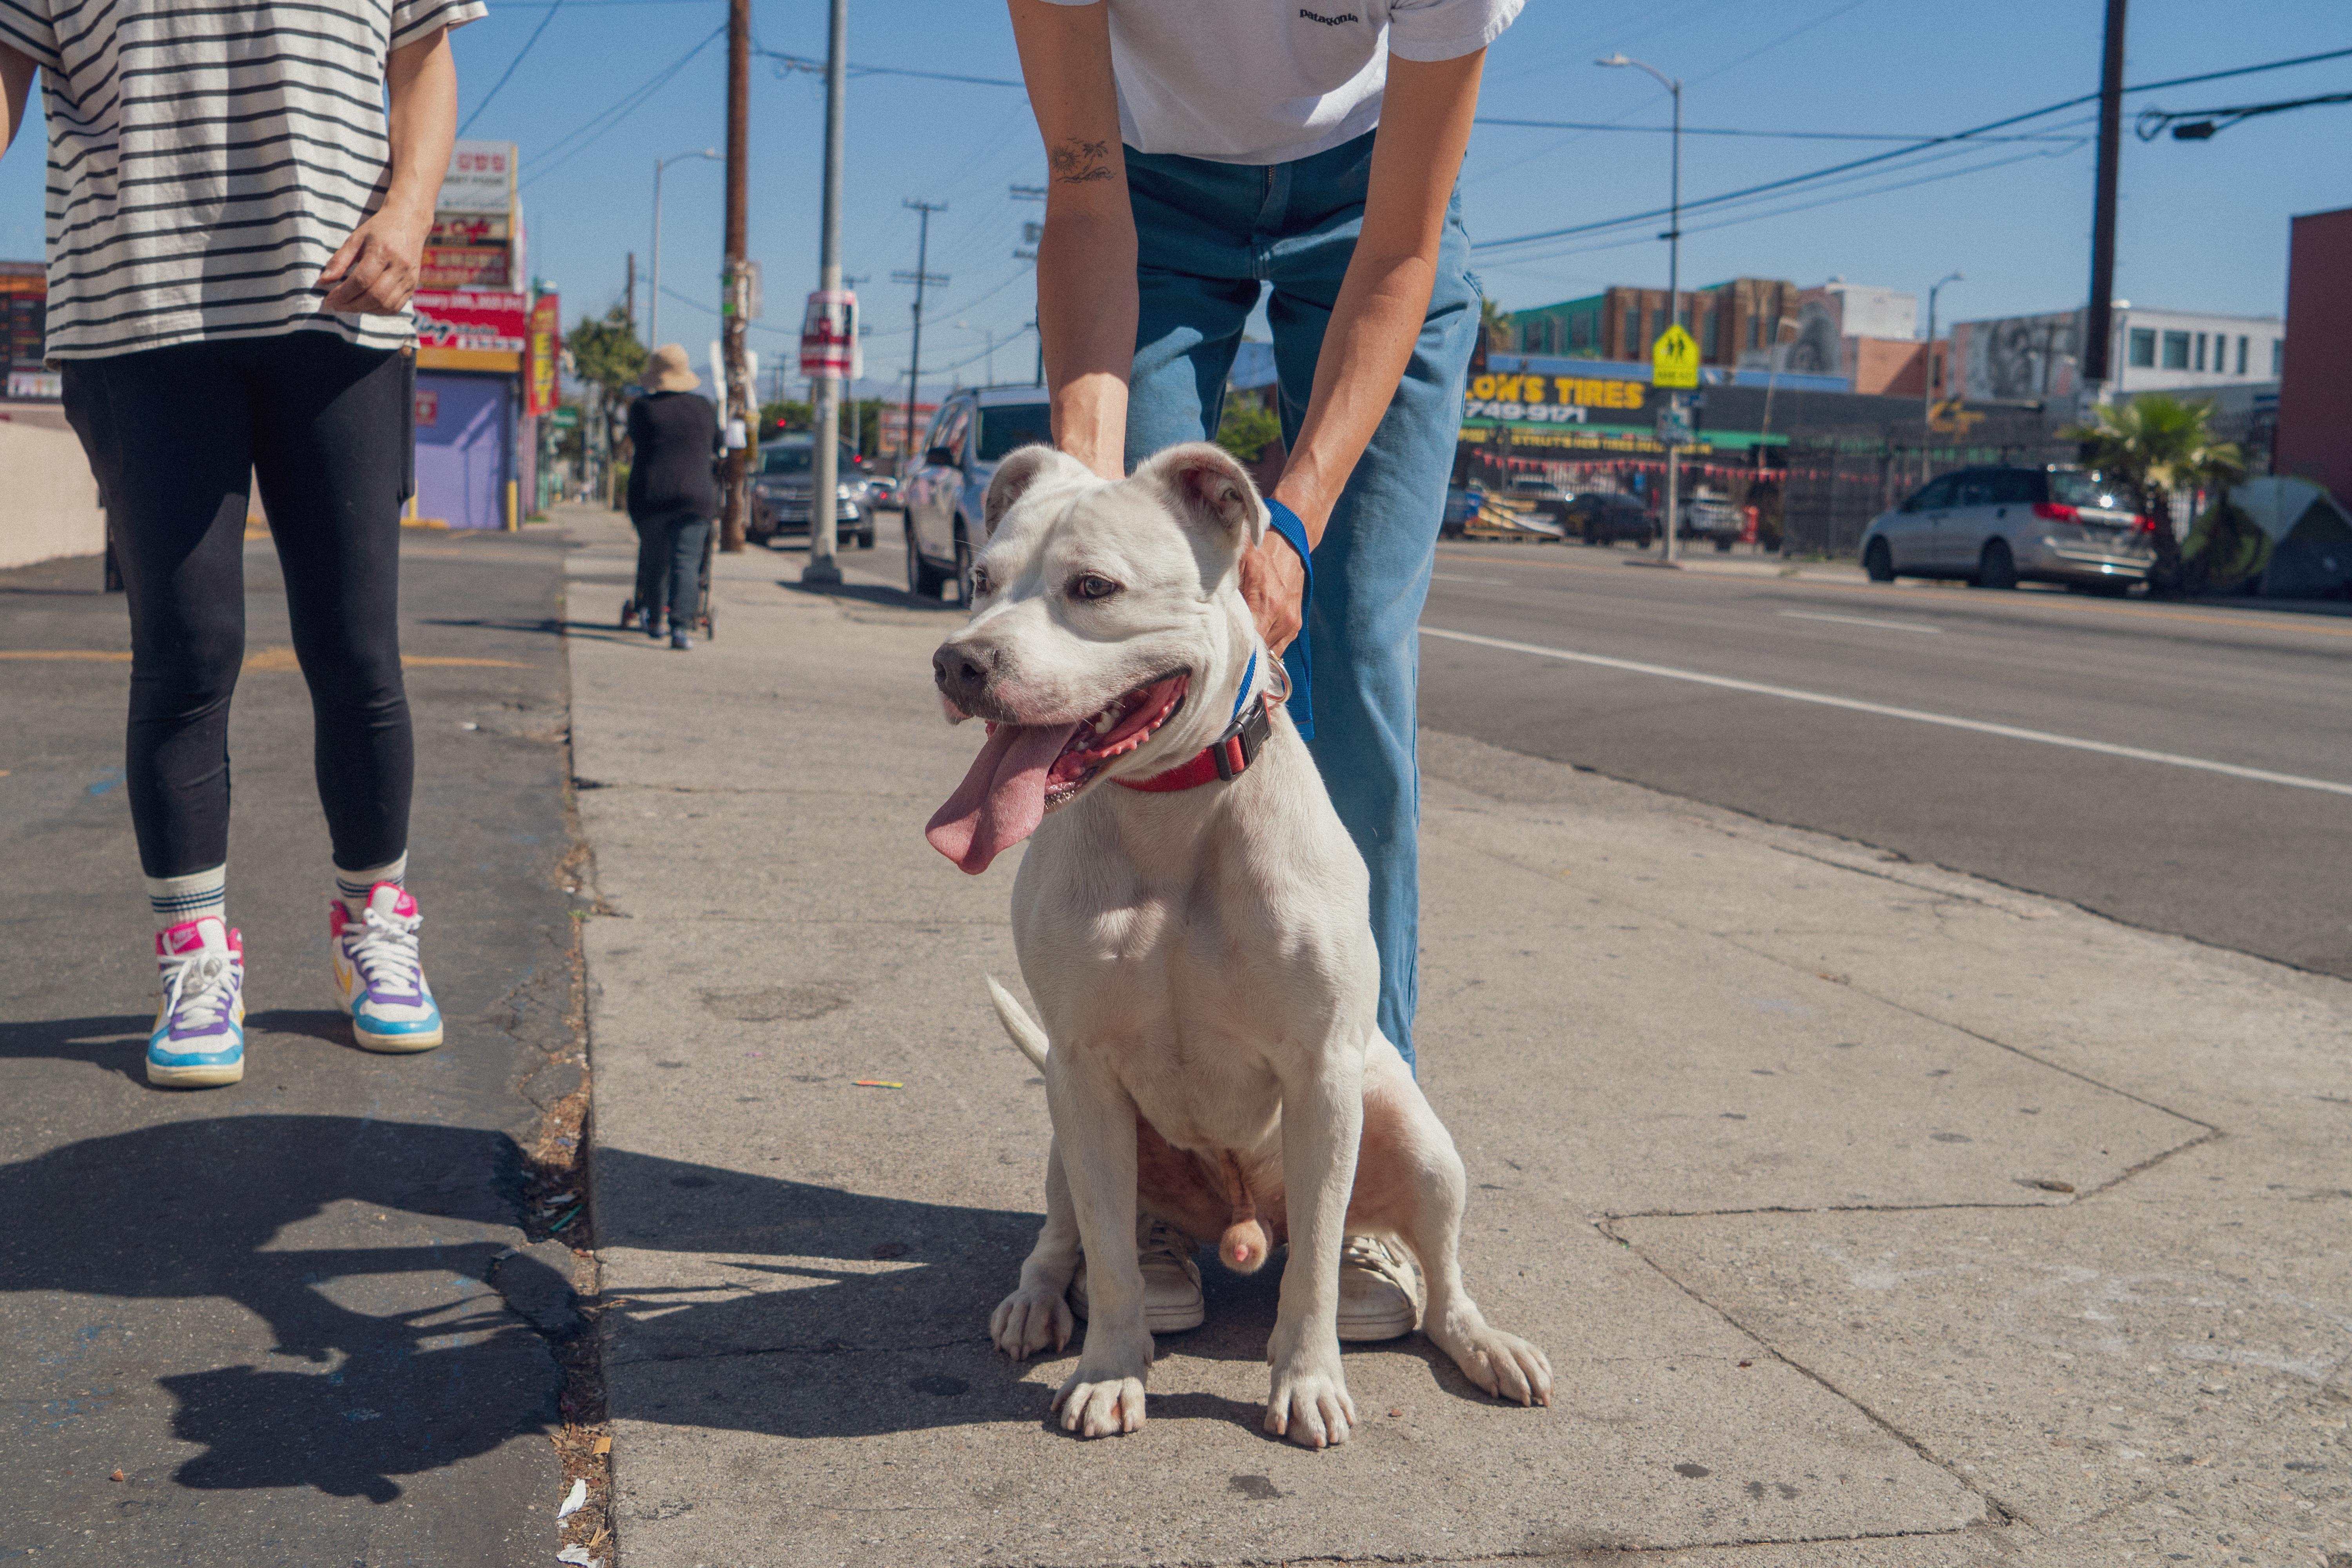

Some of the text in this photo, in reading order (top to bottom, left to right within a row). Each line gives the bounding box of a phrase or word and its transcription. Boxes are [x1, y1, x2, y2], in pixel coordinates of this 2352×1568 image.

[1299, 9, 1358, 26] patagonia
[1465, 373, 1644, 410] ON'S TIRES
